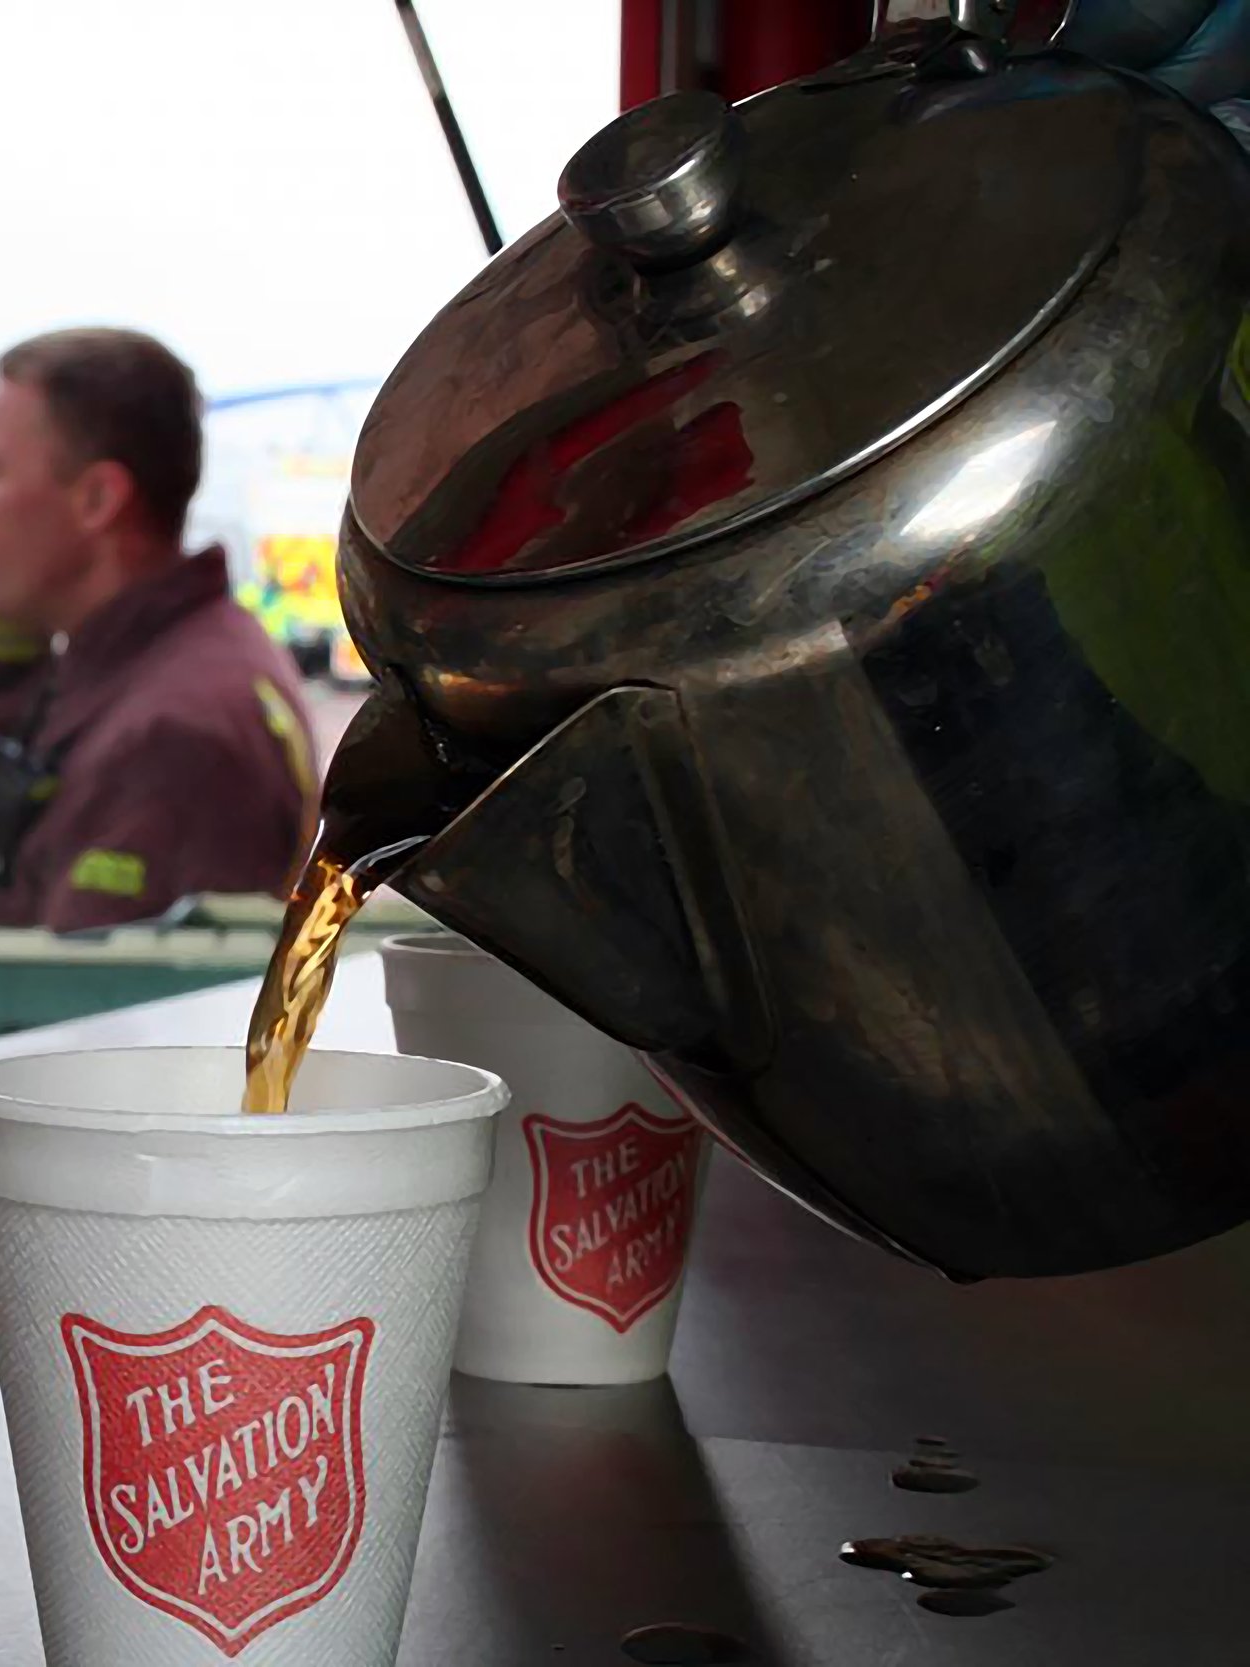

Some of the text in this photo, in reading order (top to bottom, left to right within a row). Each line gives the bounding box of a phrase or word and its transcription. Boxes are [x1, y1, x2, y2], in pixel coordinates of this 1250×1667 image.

[571, 1136, 640, 1198] THE
[110, 1363, 336, 1554] SALVATION
[126, 1359, 236, 1448] THE
[198, 1455, 328, 1596] ARMY
